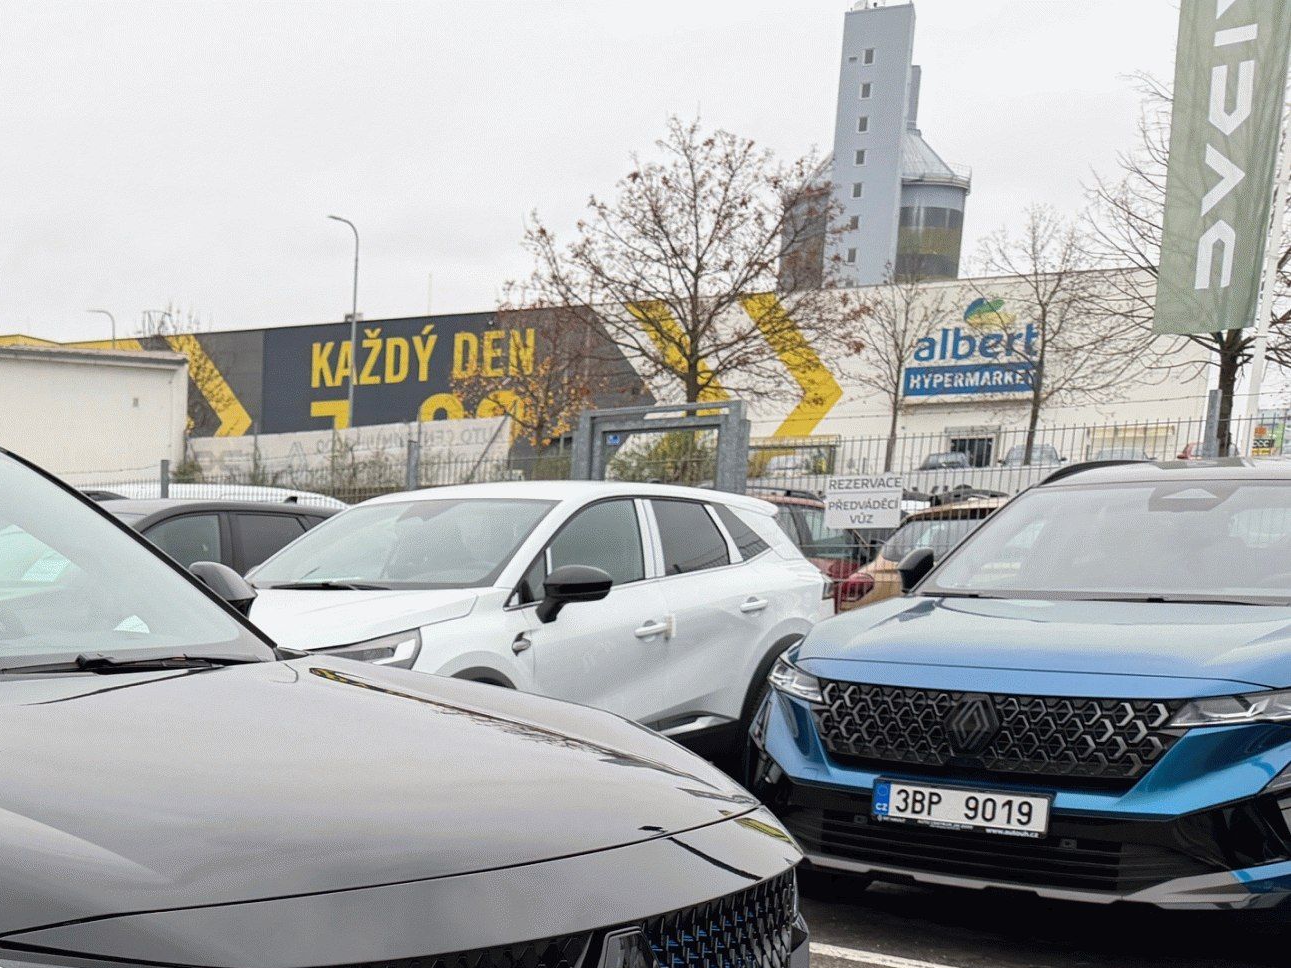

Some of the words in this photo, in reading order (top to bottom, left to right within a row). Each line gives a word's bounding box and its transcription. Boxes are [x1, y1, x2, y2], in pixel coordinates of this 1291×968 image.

[913, 323, 1039, 362] albert
[311, 324, 438, 388] KAŽDÝ
[451, 328, 535, 380] DEN
[910, 369, 1038, 390] HYPERMARKET
[828, 477, 903, 490] REZERVACE
[827, 497, 899, 511] PŘEDVÁDĚCÍ
[849, 512, 874, 524] VŮZ
[875, 803, 889, 812] CZ
[895, 789, 942, 816] 3BP
[964, 796, 1033, 826] 9019
